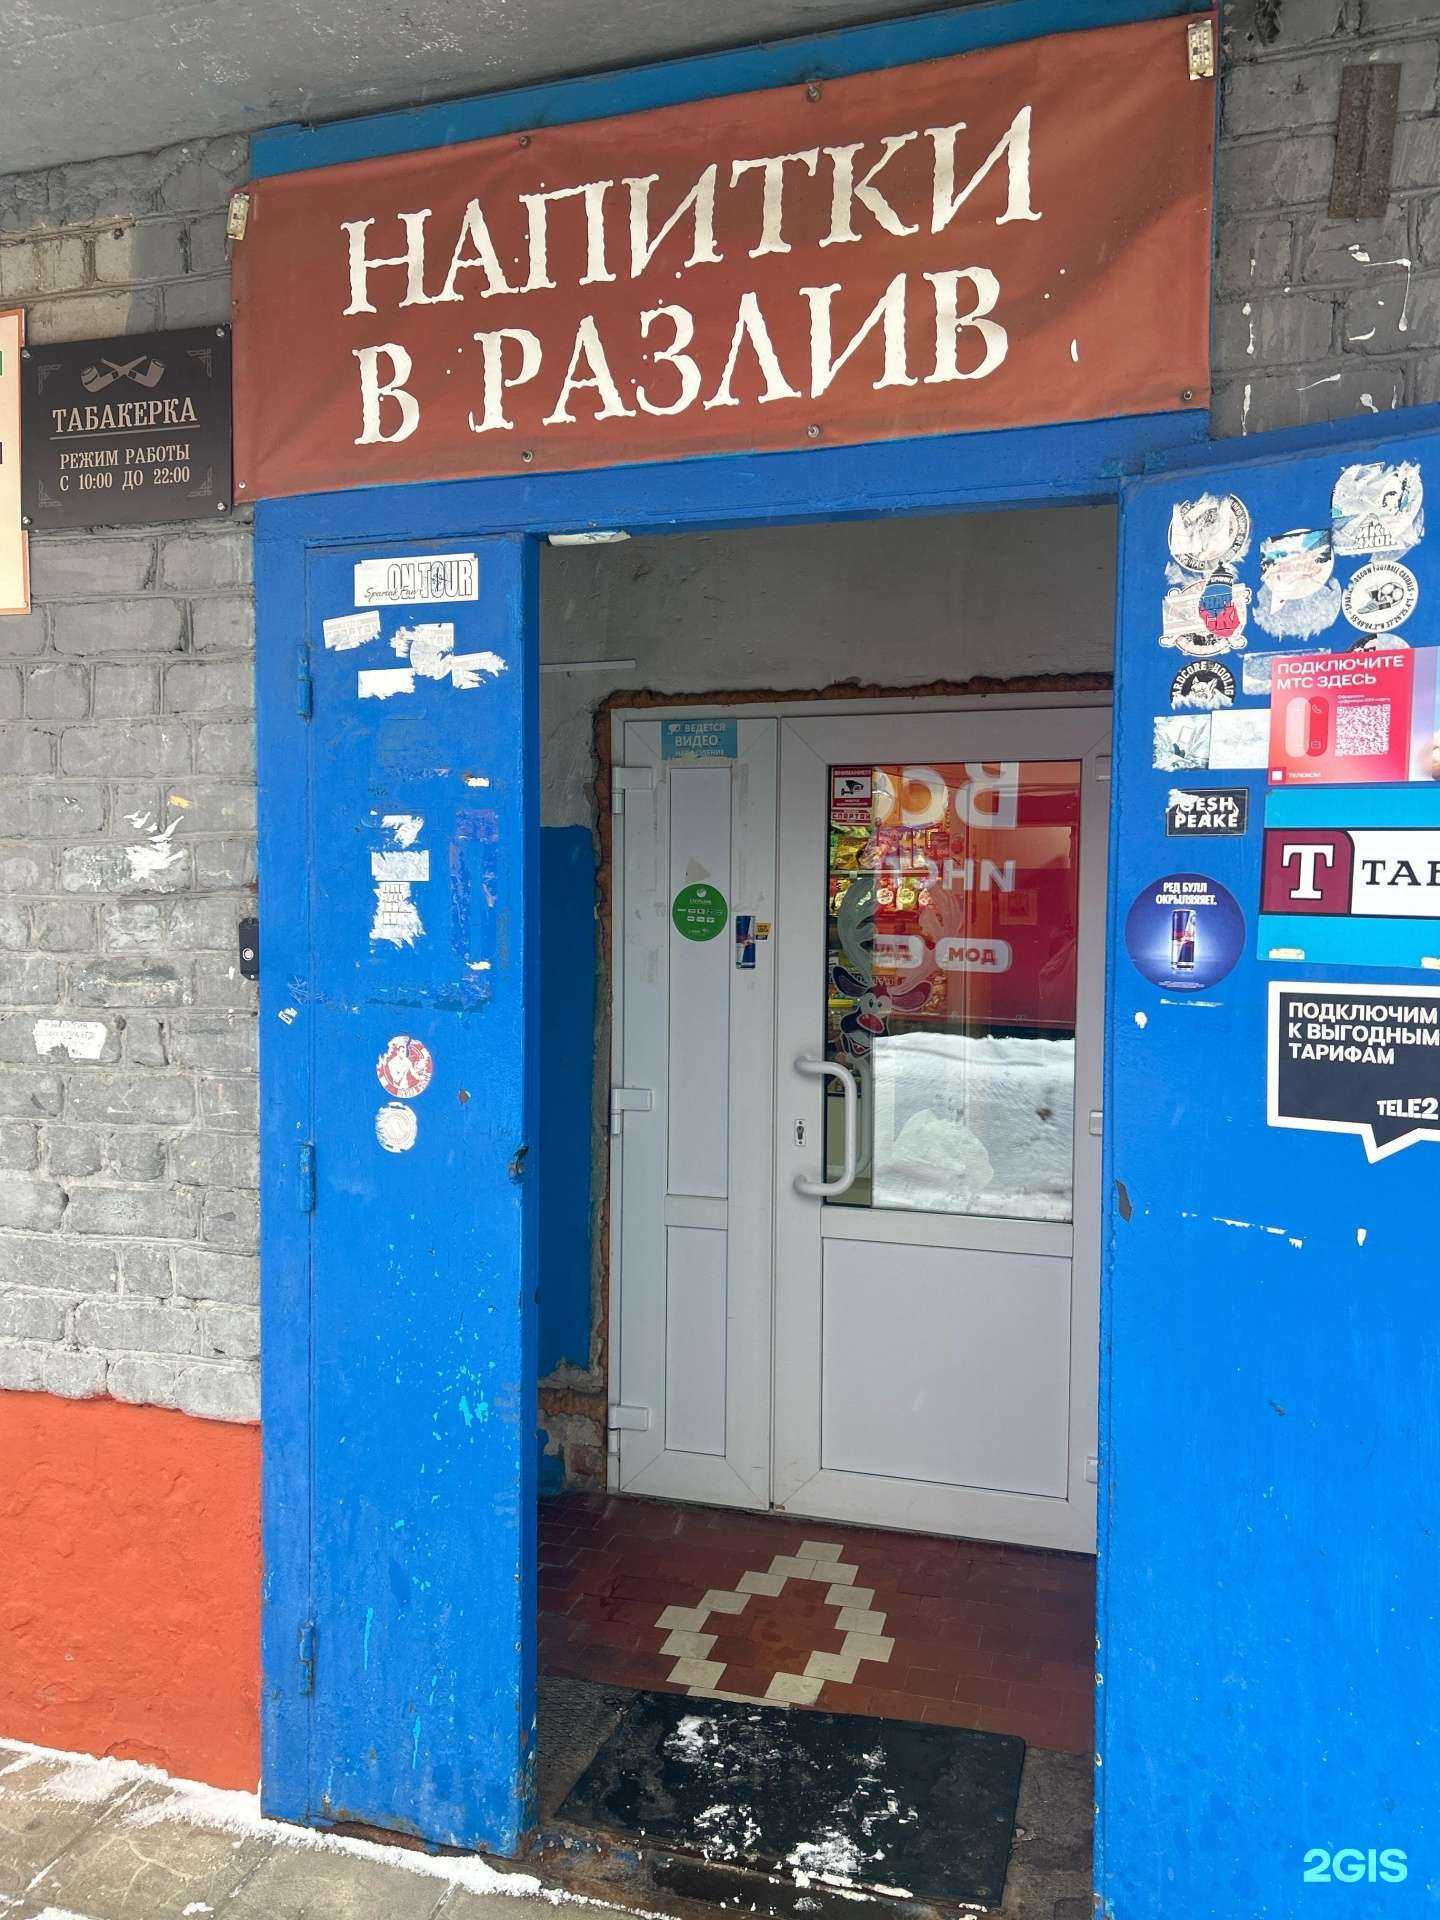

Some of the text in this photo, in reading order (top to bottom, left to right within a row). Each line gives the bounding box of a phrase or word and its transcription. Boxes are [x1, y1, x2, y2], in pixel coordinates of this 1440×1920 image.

[340, 104, 1043, 317] НАПИТКИ
[352, 265, 1009, 446] В РАЗЛИВ
[52, 397, 198, 433] ТАБАКЕРКА
[59, 444, 191, 470] РЕЖИМ РАБОТЫ
[59, 466, 191, 491] С 10:00 ДО 22:00
[387, 560, 473, 601] ON TOUR
[1276, 655, 1405, 675] ПОДКЛЮЧИТЕ
[1276, 673, 1377, 690] МТС ЗДЕСЬ
[675, 734, 719, 748] ВИДЕО
[1174, 813, 1238, 829] PEAKE
[1162, 881, 1208, 895] РЕД БУЛЛ
[1288, 1001, 1438, 1025] ПОДКЛЮЧИМ
[1288, 1022, 1440, 1047] К ВЫГОДНЫМ
[1288, 1042, 1395, 1065] ТАРИФАМ
[1376, 1096, 1439, 1121] TELE2
